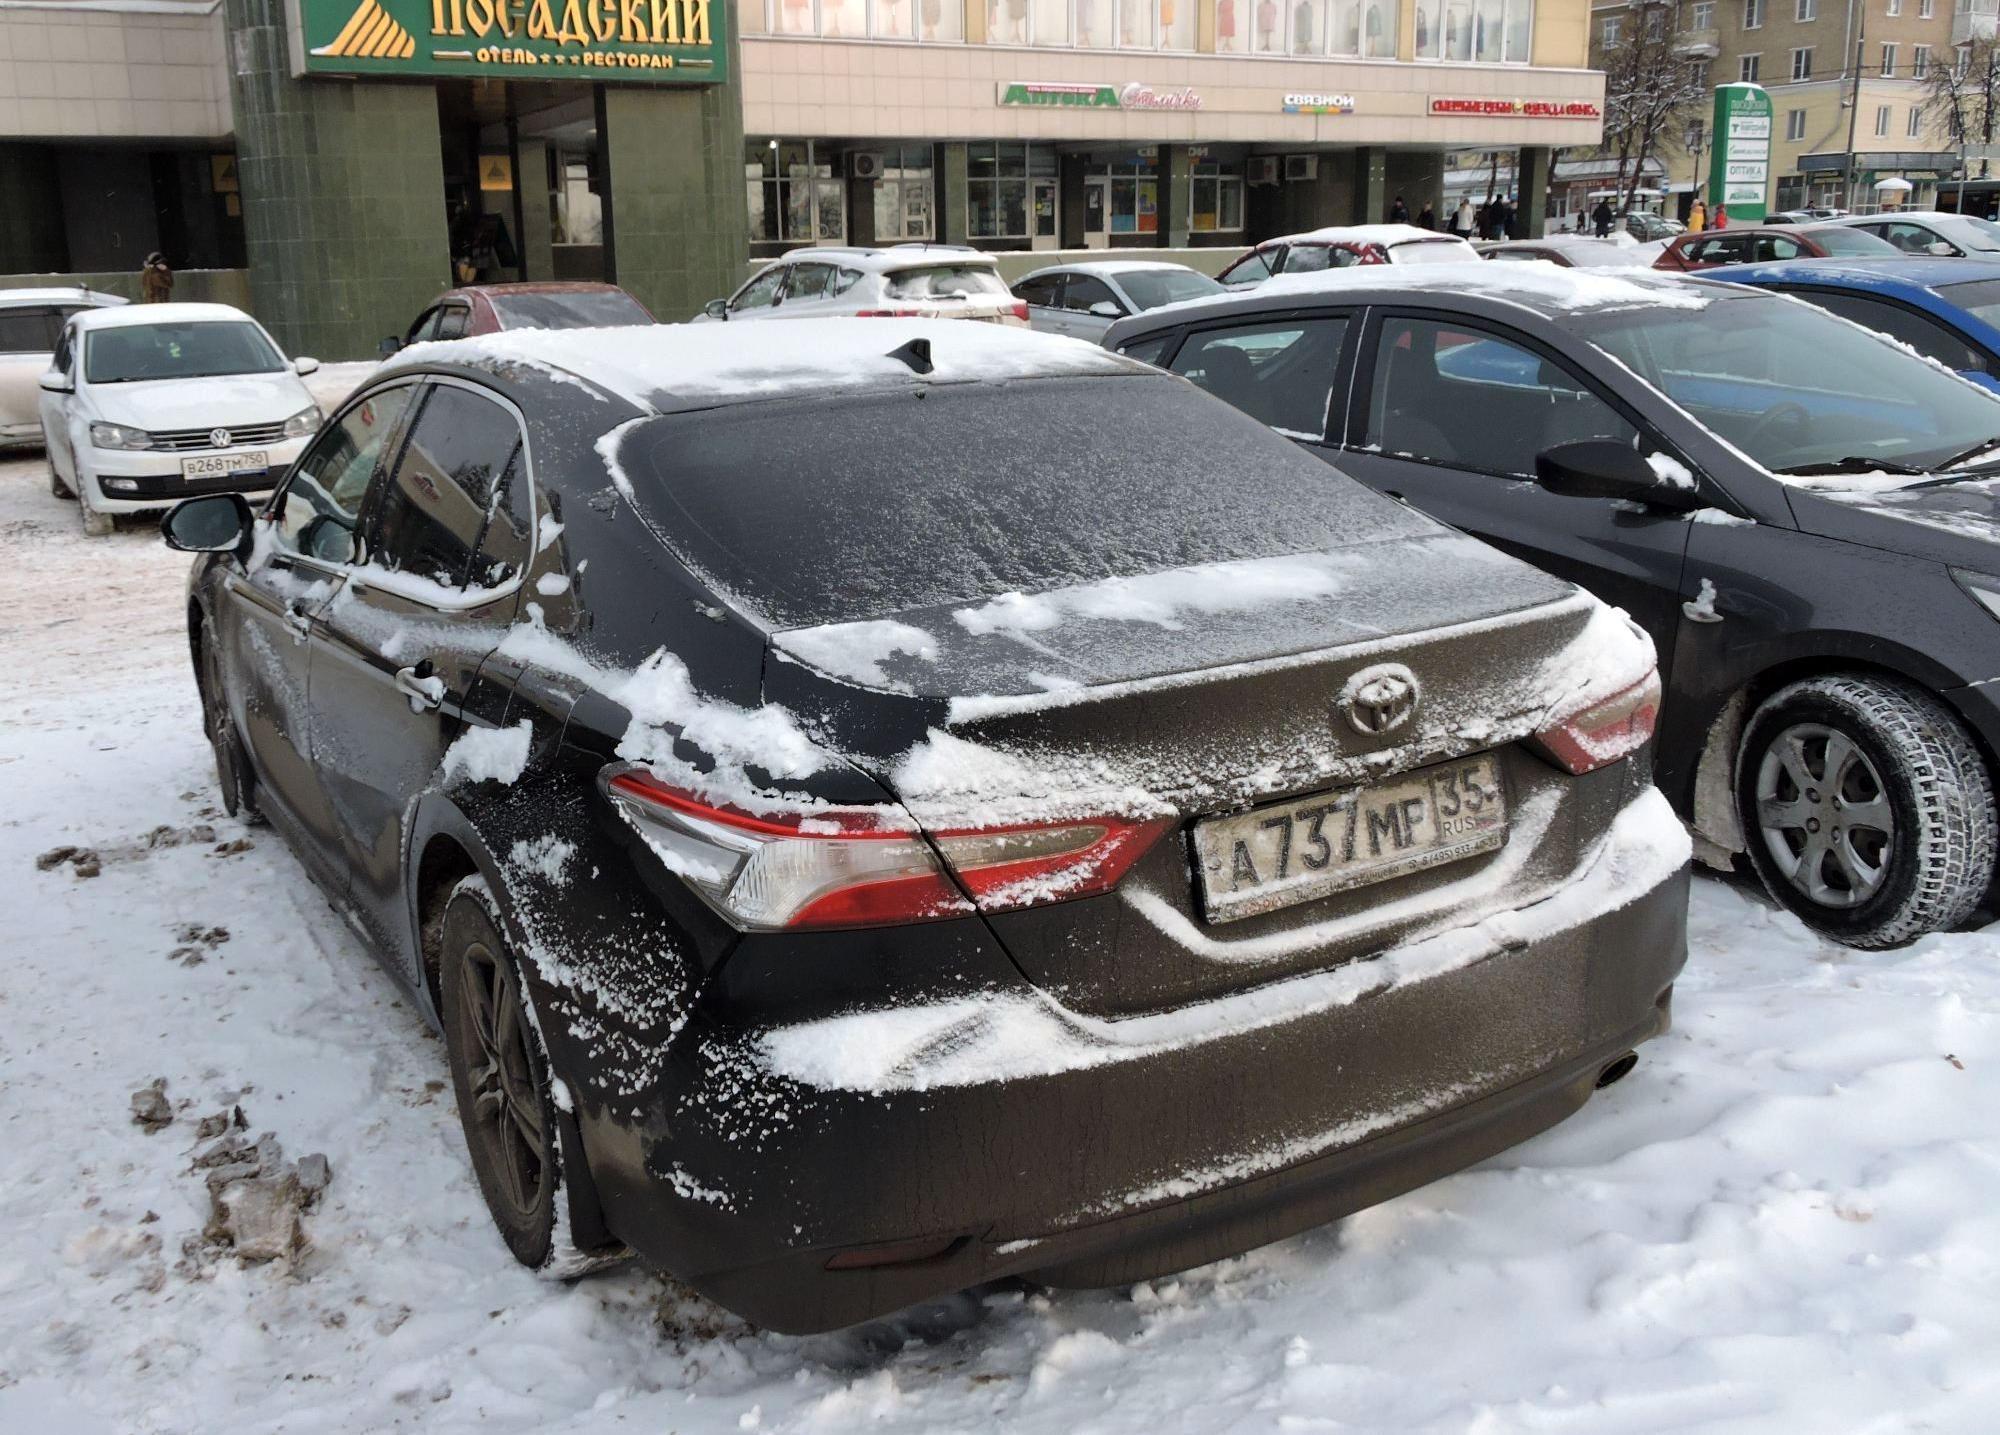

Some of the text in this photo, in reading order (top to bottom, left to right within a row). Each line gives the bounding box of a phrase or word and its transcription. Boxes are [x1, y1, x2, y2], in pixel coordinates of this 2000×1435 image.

[476, 45, 673, 68] ОТЕЛЬ РЕСТОРАН
[1284, 93, 1355, 107] СВЯЗНОЙ
[1730, 166, 1762, 176] ОПТИКА
[243, 453, 264, 465] 750
[1436, 767, 1484, 816] 35
[1443, 815, 1474, 838] RUS
